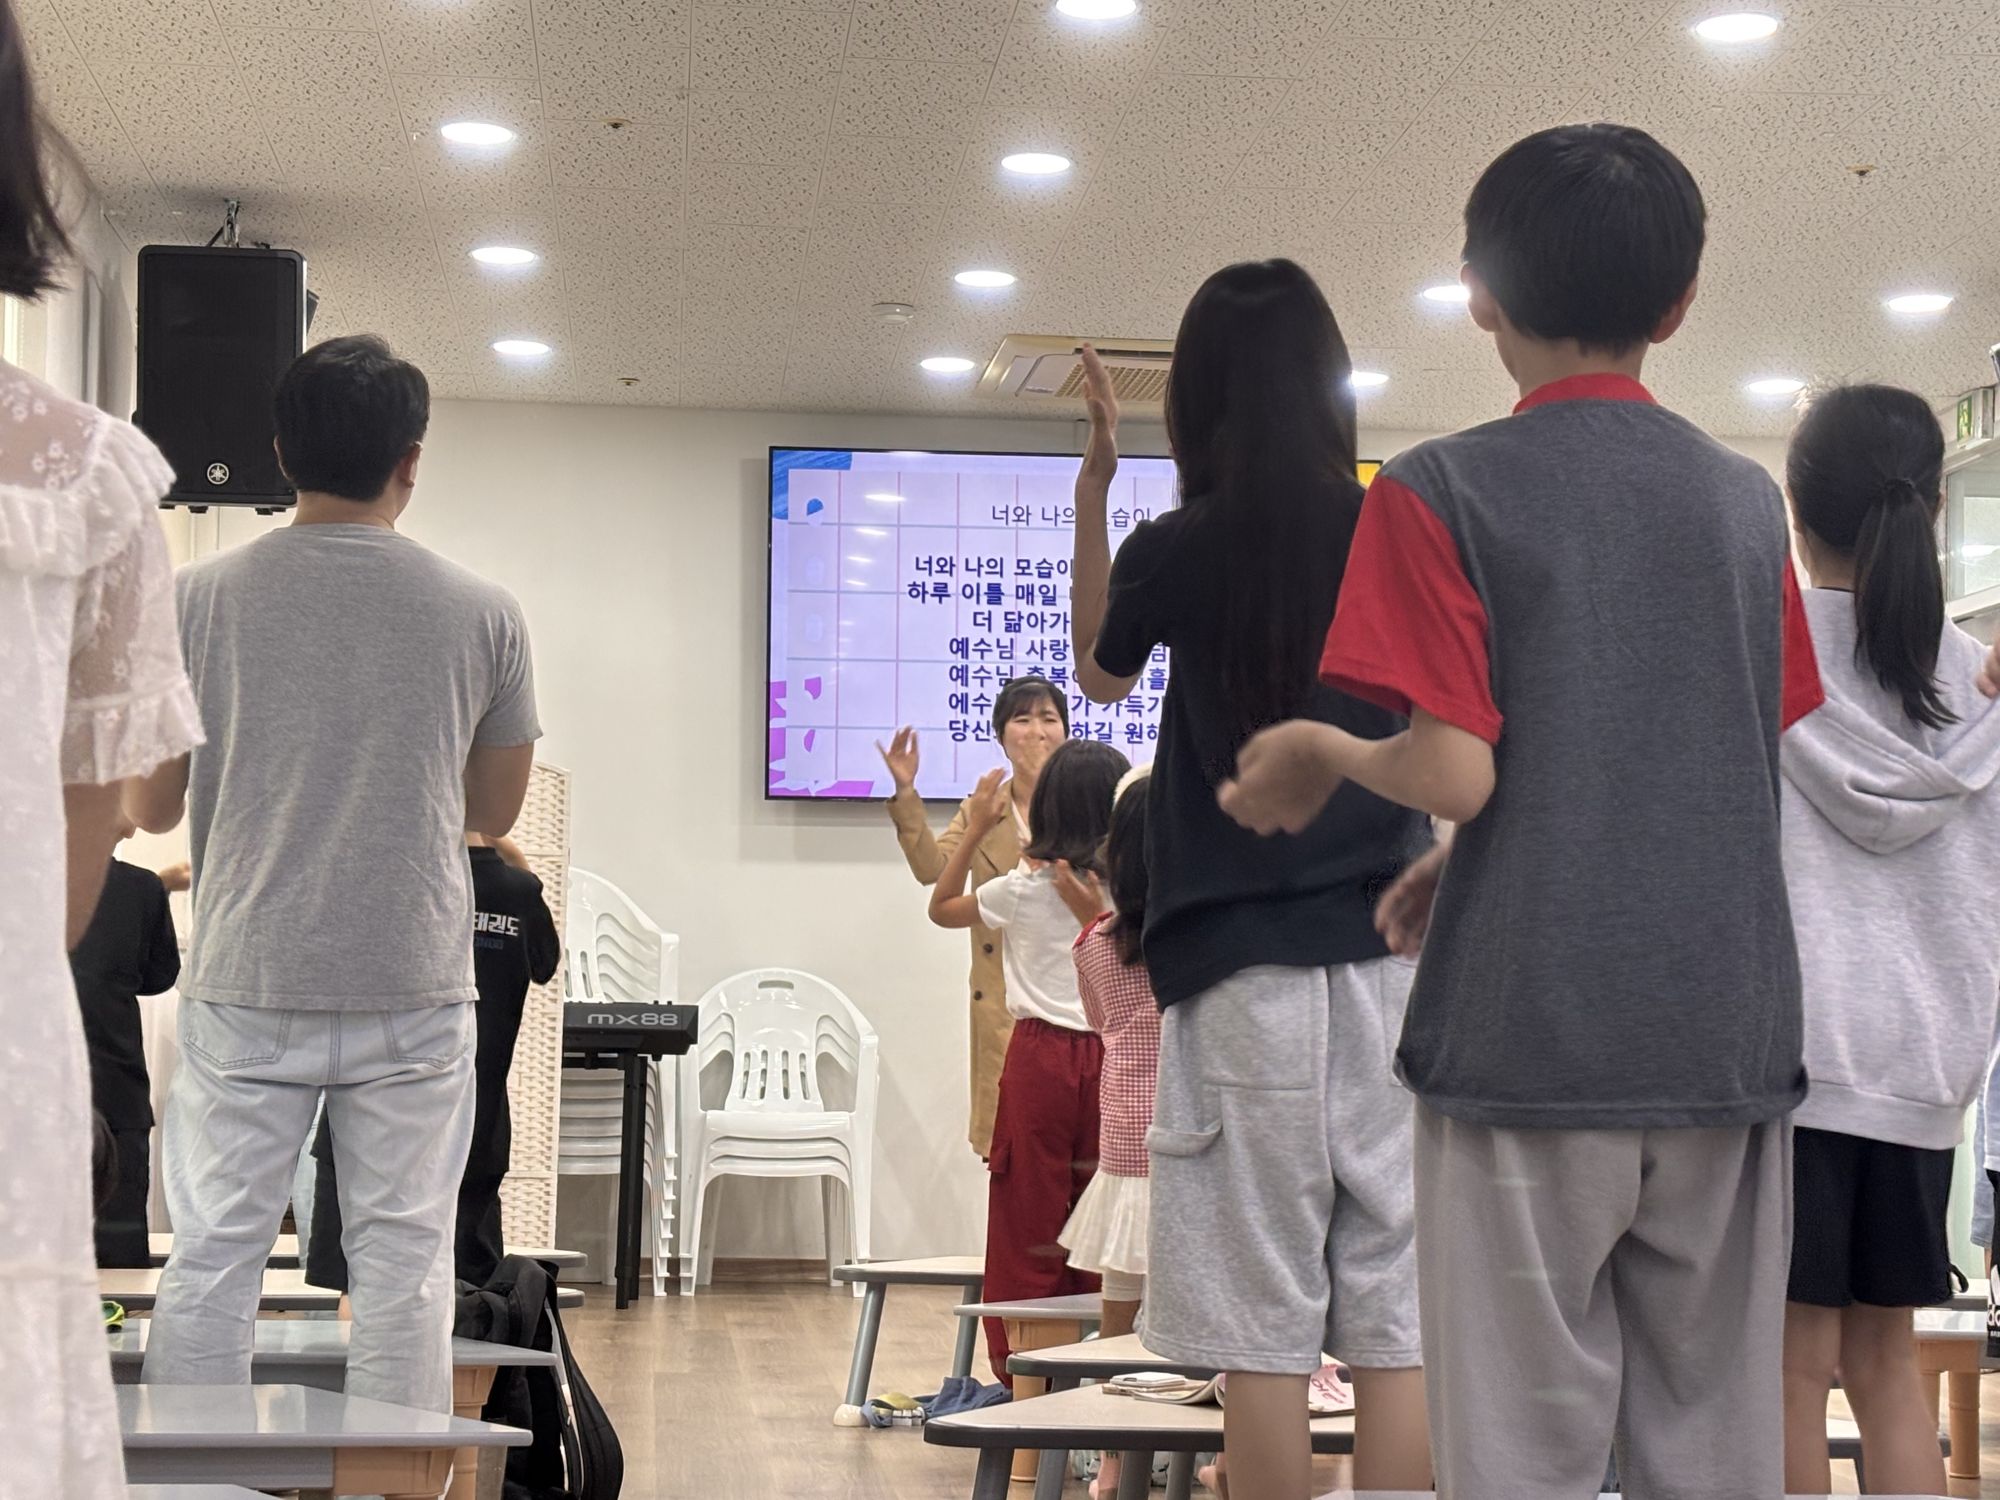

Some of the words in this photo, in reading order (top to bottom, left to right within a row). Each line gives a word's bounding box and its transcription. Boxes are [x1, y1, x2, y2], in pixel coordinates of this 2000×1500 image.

[992, 504, 1032, 527] 너와
[1107, 507, 1151, 529] 습이
[915, 555, 956, 577] 너와
[965, 556, 1004, 578] 나의
[1013, 558, 1074, 579] 모습이
[907, 581, 951, 604] 하루
[1015, 583, 1057, 607] 매일
[973, 610, 992, 633] 더
[1003, 610, 1070, 634] 닮아가
[949, 637, 1014, 660] 예수님
[1025, 638, 1070, 661] 사랑
[949, 664, 1014, 688] 예수님
[948, 692, 998, 715] 에수
[949, 719, 997, 742] 당신
